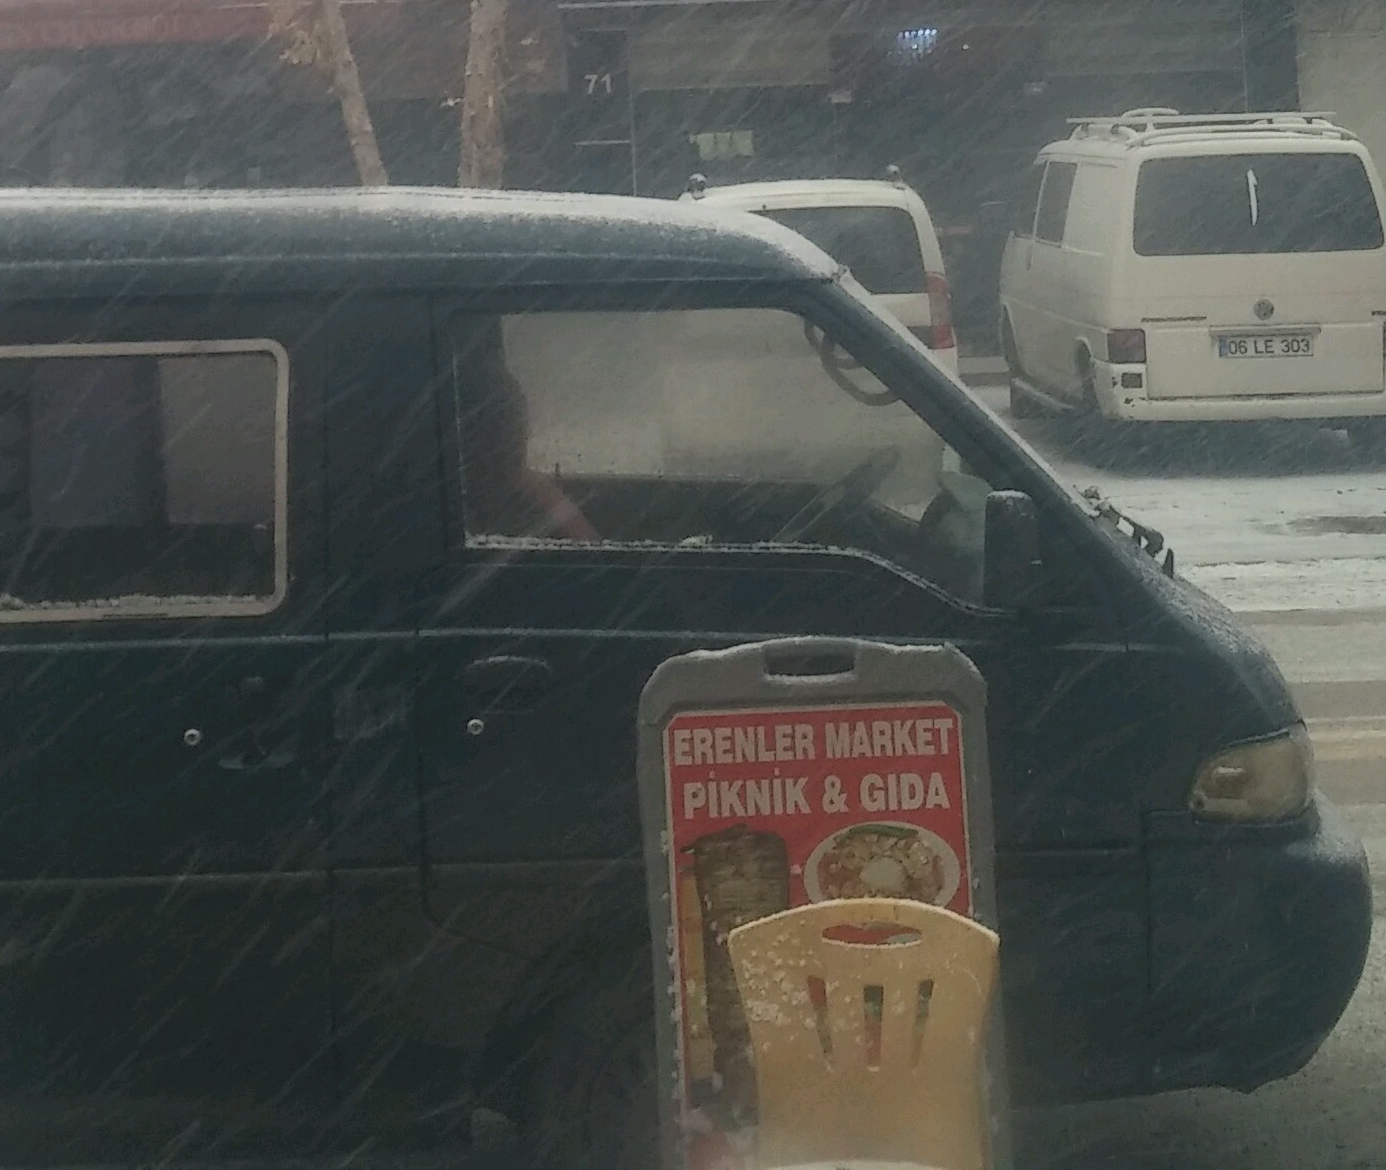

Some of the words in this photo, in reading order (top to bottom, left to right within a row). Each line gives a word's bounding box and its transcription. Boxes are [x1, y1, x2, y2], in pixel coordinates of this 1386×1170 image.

[584, 74, 612, 94] 71
[1229, 340, 1247, 355] 06
[1254, 338, 1275, 354] LE
[1281, 337, 1310, 353] 303
[674, 723, 814, 766] ERENLER
[825, 719, 952, 758] MARKET
[684, 768, 811, 819] PİKNİK
[823, 775, 849, 814] &
[859, 772, 950, 810] GIDA
